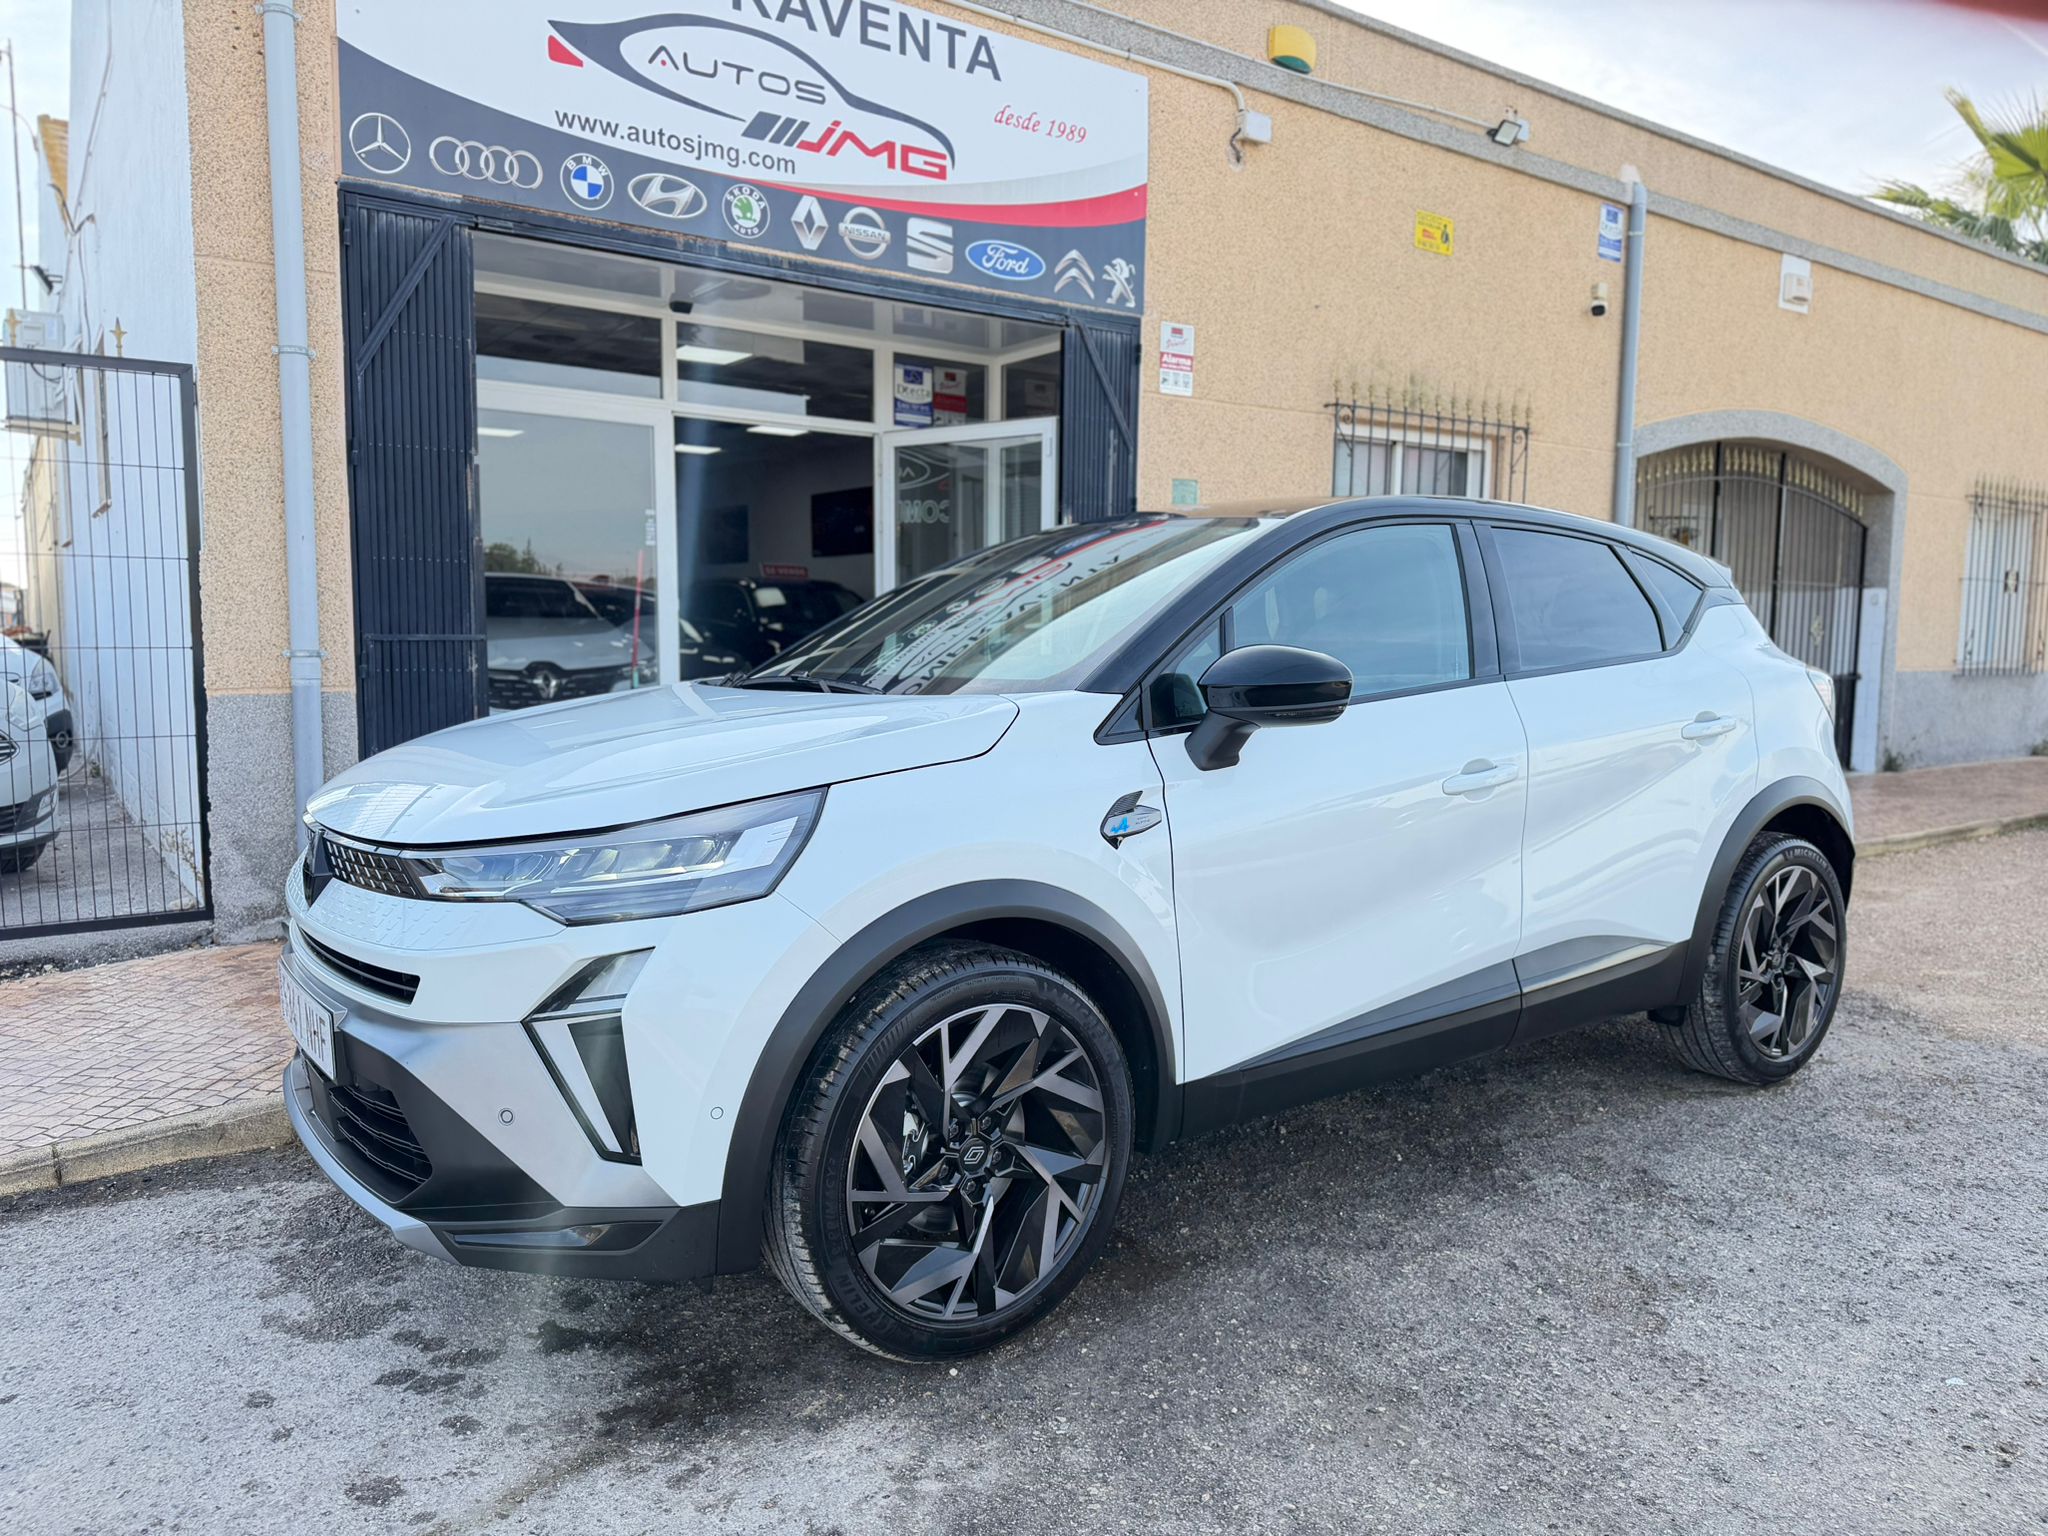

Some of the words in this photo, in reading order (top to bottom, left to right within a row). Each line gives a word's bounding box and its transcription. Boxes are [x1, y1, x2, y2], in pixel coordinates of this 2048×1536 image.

[648, 45, 826, 105] AUTOS
[993, 105, 1042, 134] desde
[1046, 119, 1088, 144] 1989
[554, 109, 796, 175] www.autosjmg.com
[566, 155, 609, 178] BMW
[733, 224, 759, 235] AUTO
[843, 225, 887, 241] NISSAN
[981, 243, 1029, 275] Ford
[1161, 353, 1192, 367] Alarma
